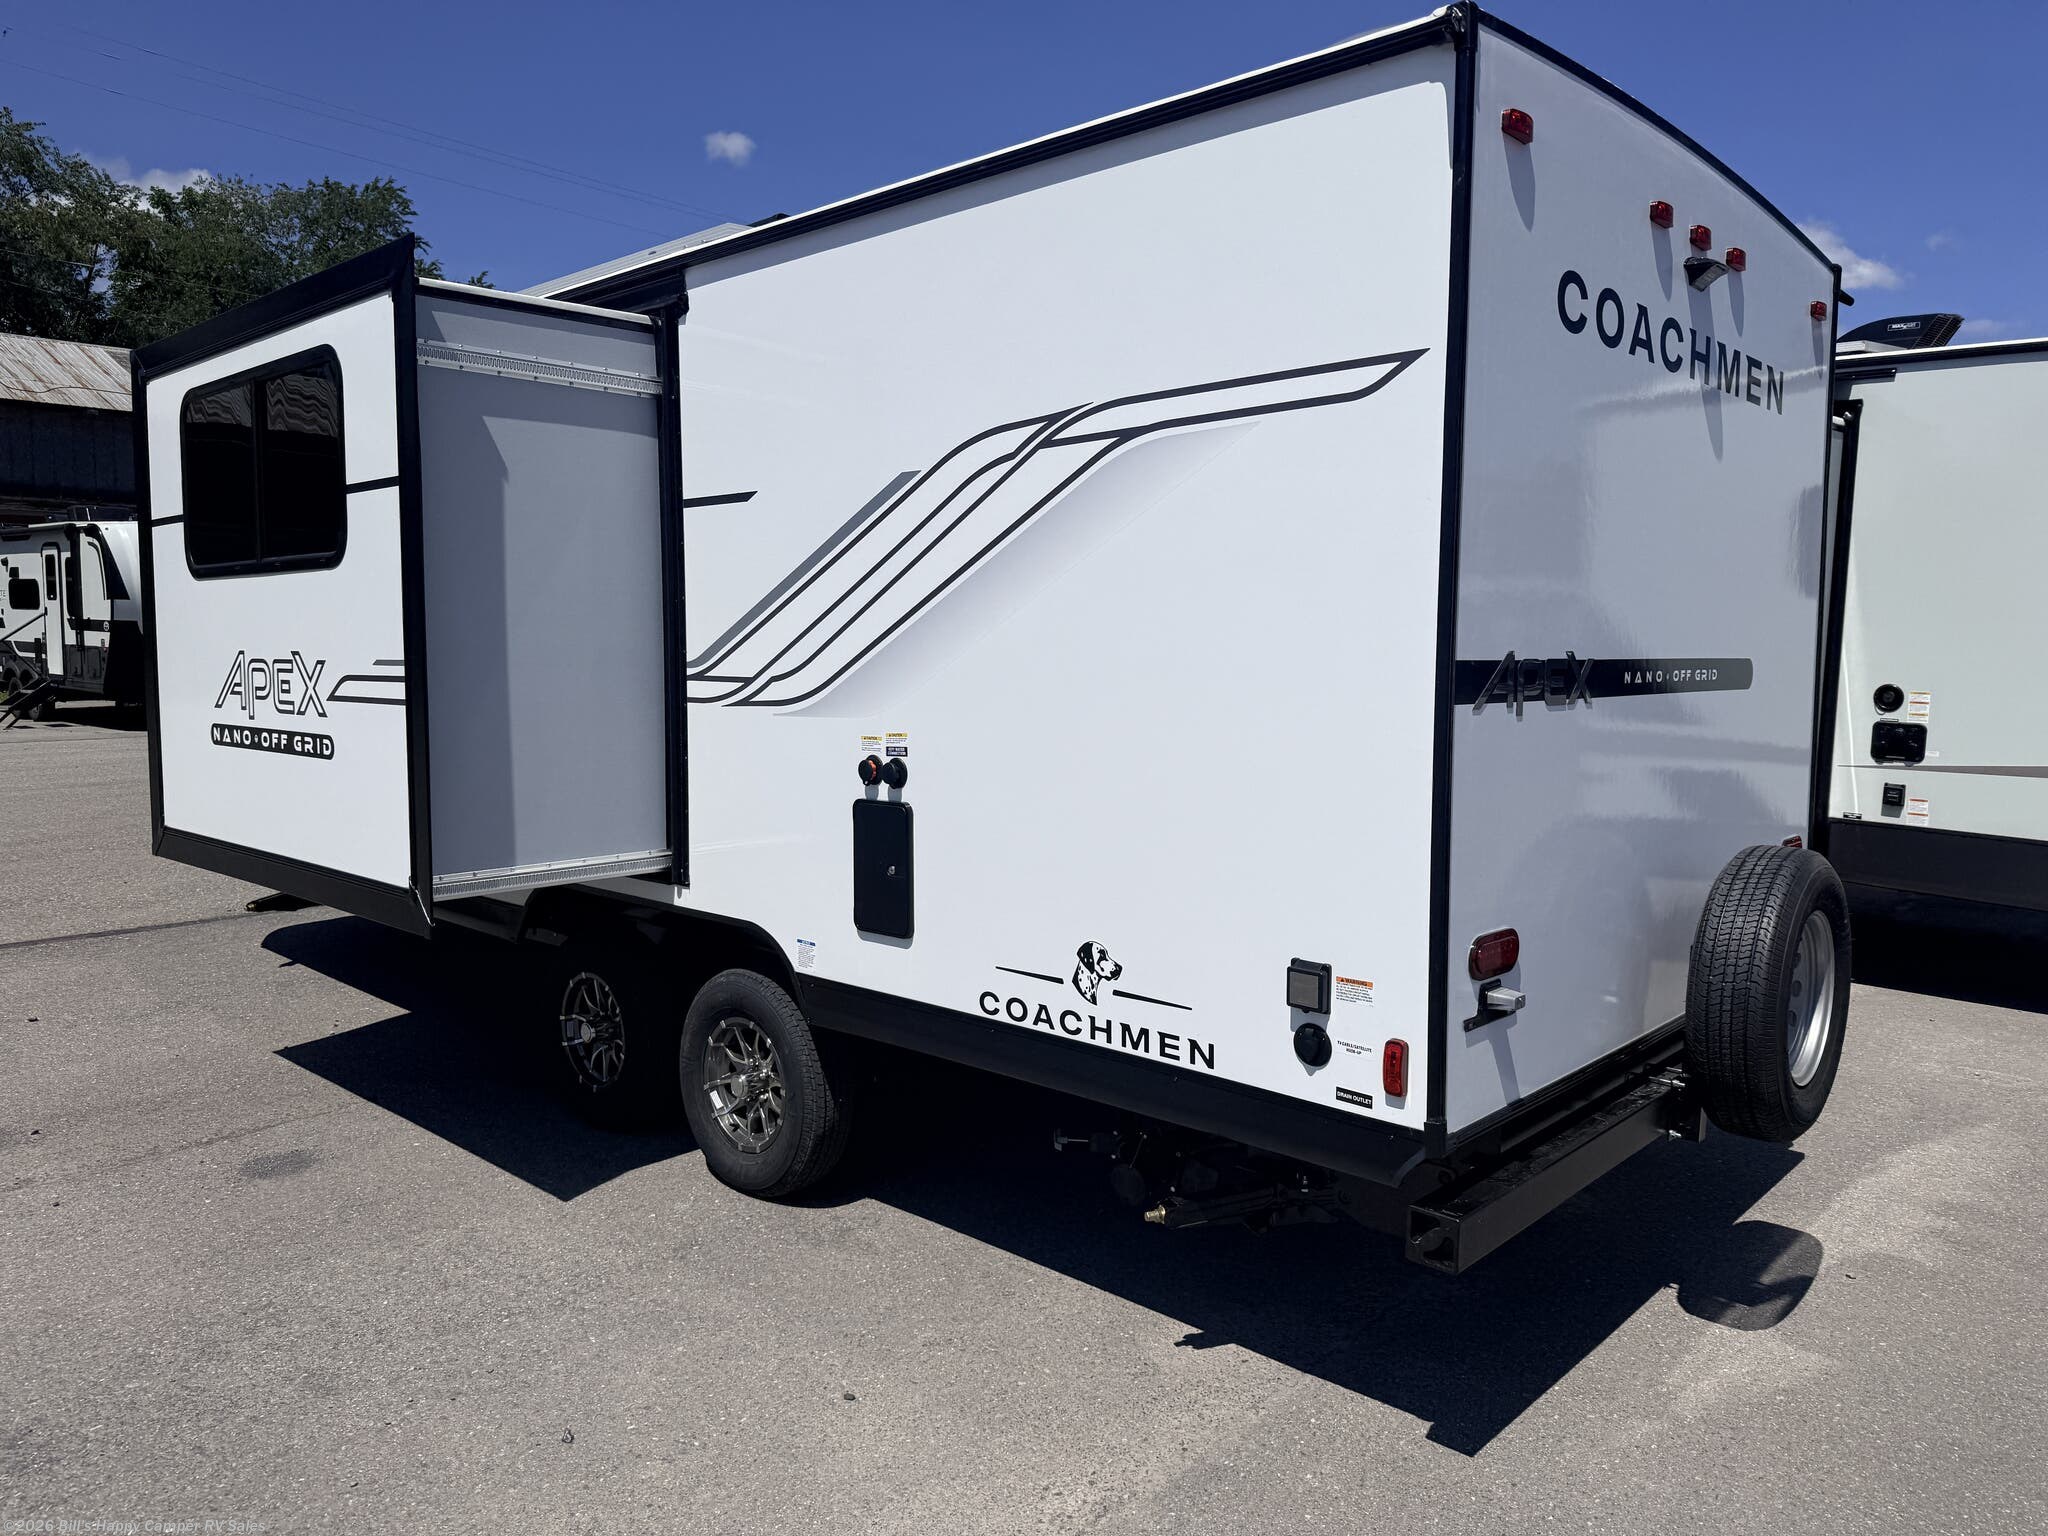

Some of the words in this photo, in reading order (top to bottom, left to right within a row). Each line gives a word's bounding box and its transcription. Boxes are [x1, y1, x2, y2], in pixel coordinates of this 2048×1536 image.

[1557, 269, 1784, 415] COACHMEN
[1695, 668, 1718, 681] GRID
[293, 735, 332, 756] GRID
[979, 991, 1215, 1070] COACHMEN
[1353, 1095, 1371, 1105] OUTLET
